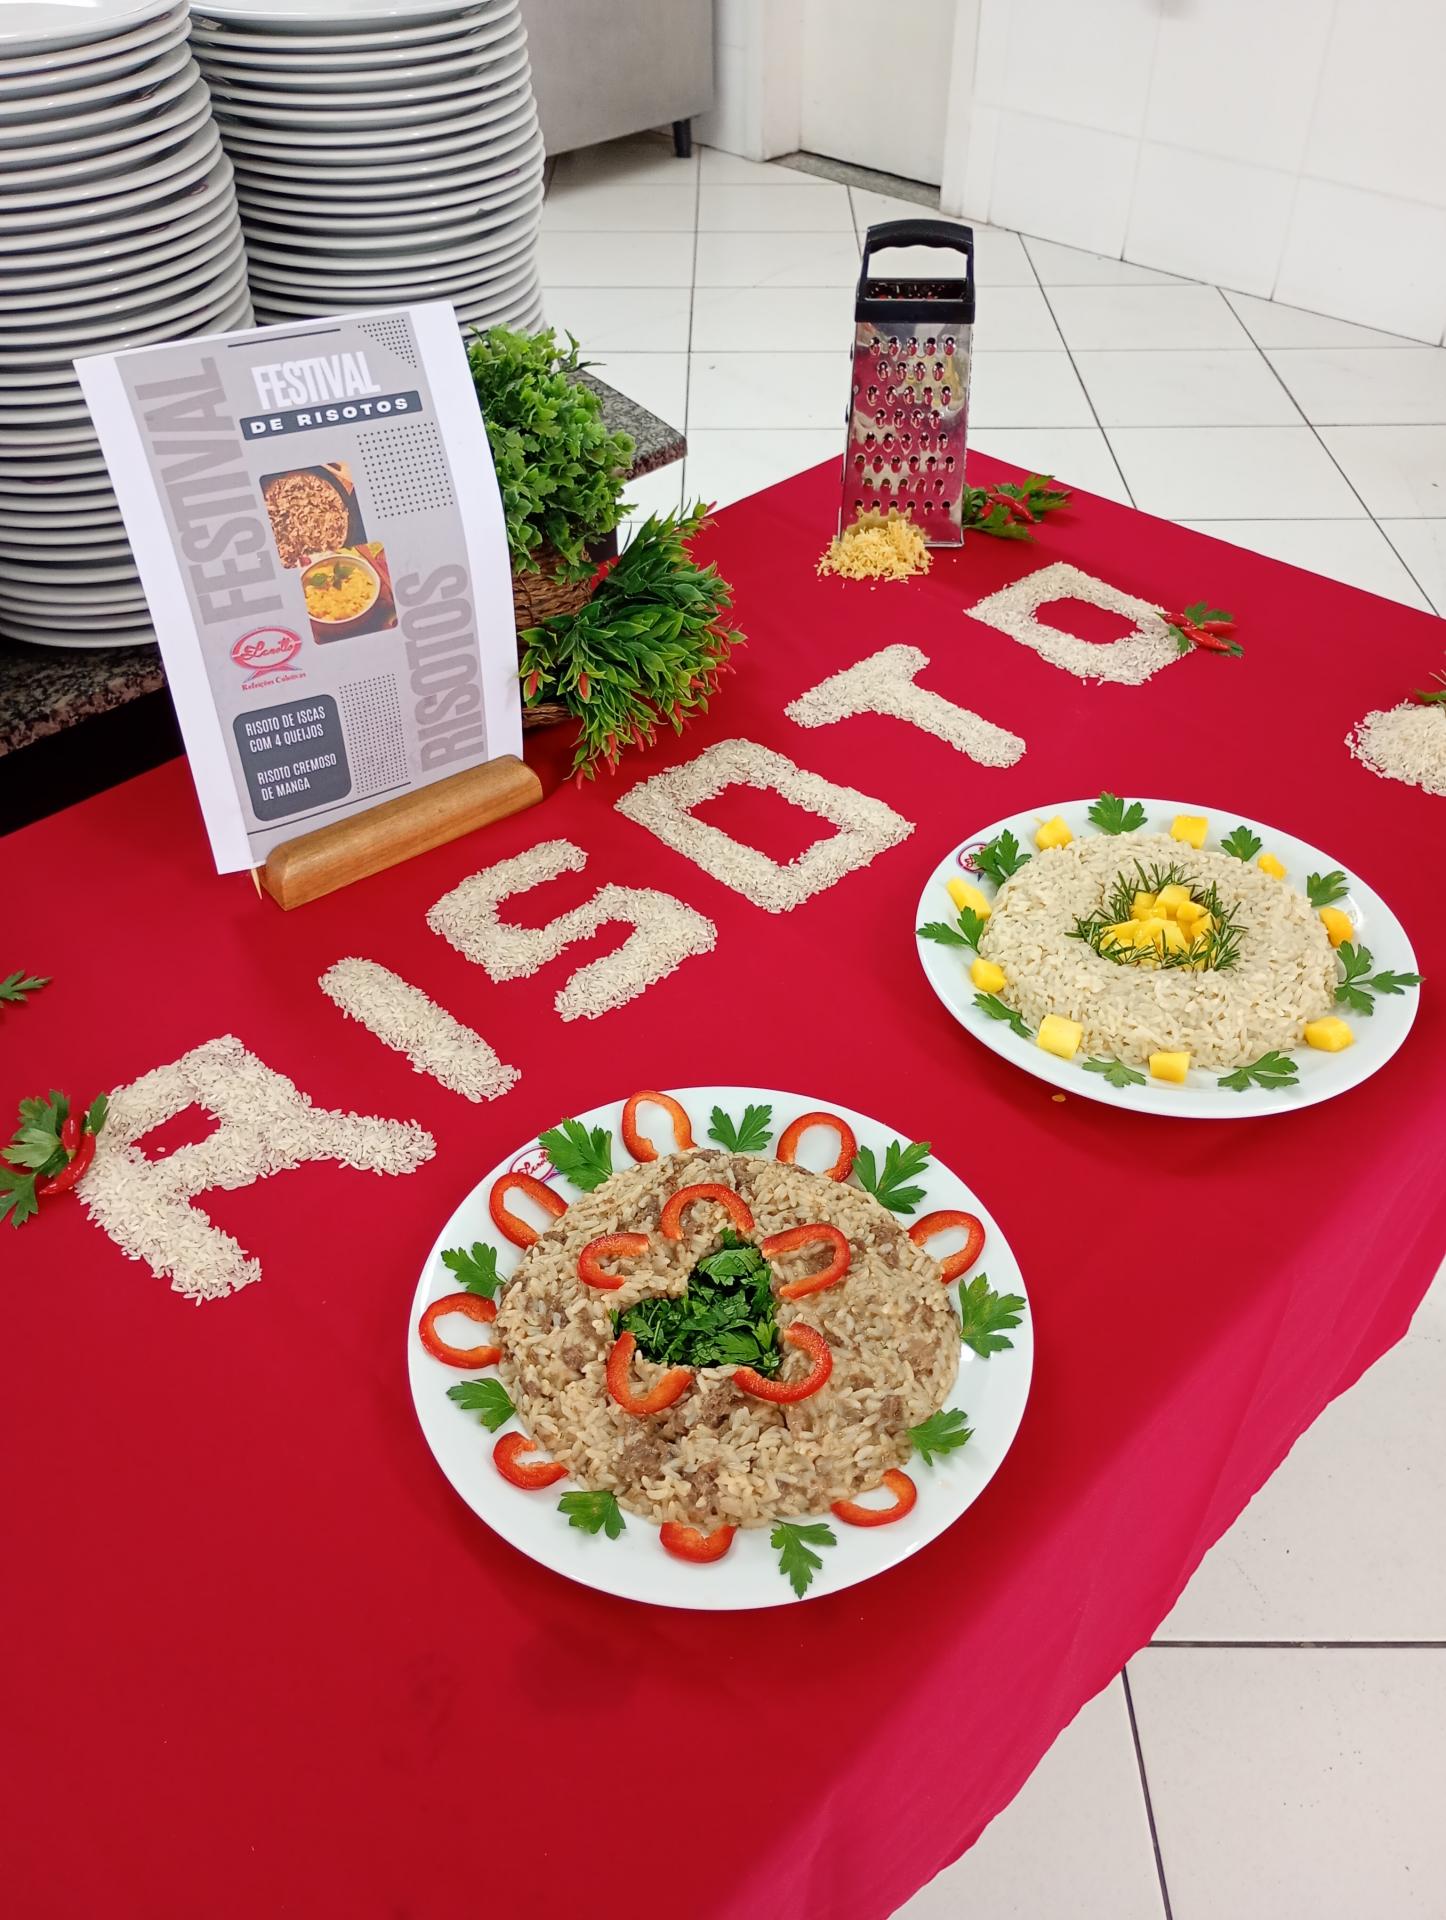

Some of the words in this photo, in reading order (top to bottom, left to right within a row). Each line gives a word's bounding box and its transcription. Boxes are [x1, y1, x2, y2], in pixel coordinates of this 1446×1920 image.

[251, 351, 382, 410] FESTIVAL
[250, 418, 284, 434] DE
[297, 398, 408, 427] RISOTOS
[134, 357, 284, 625] FESTIVAL
[395, 564, 485, 772] RISOTOS
[245, 717, 279, 737] RISOTO
[282, 713, 295, 728] DE
[297, 705, 326, 725] ISCAS
[249, 735, 273, 753] COM
[275, 735, 282, 747] 4
[284, 723, 324, 746] QUEIJOS
[257, 766, 291, 786] RISOTO
[293, 753, 337, 777] CREMOSO
[261, 787, 274, 802] DE
[276, 777, 311, 798] MANGA
